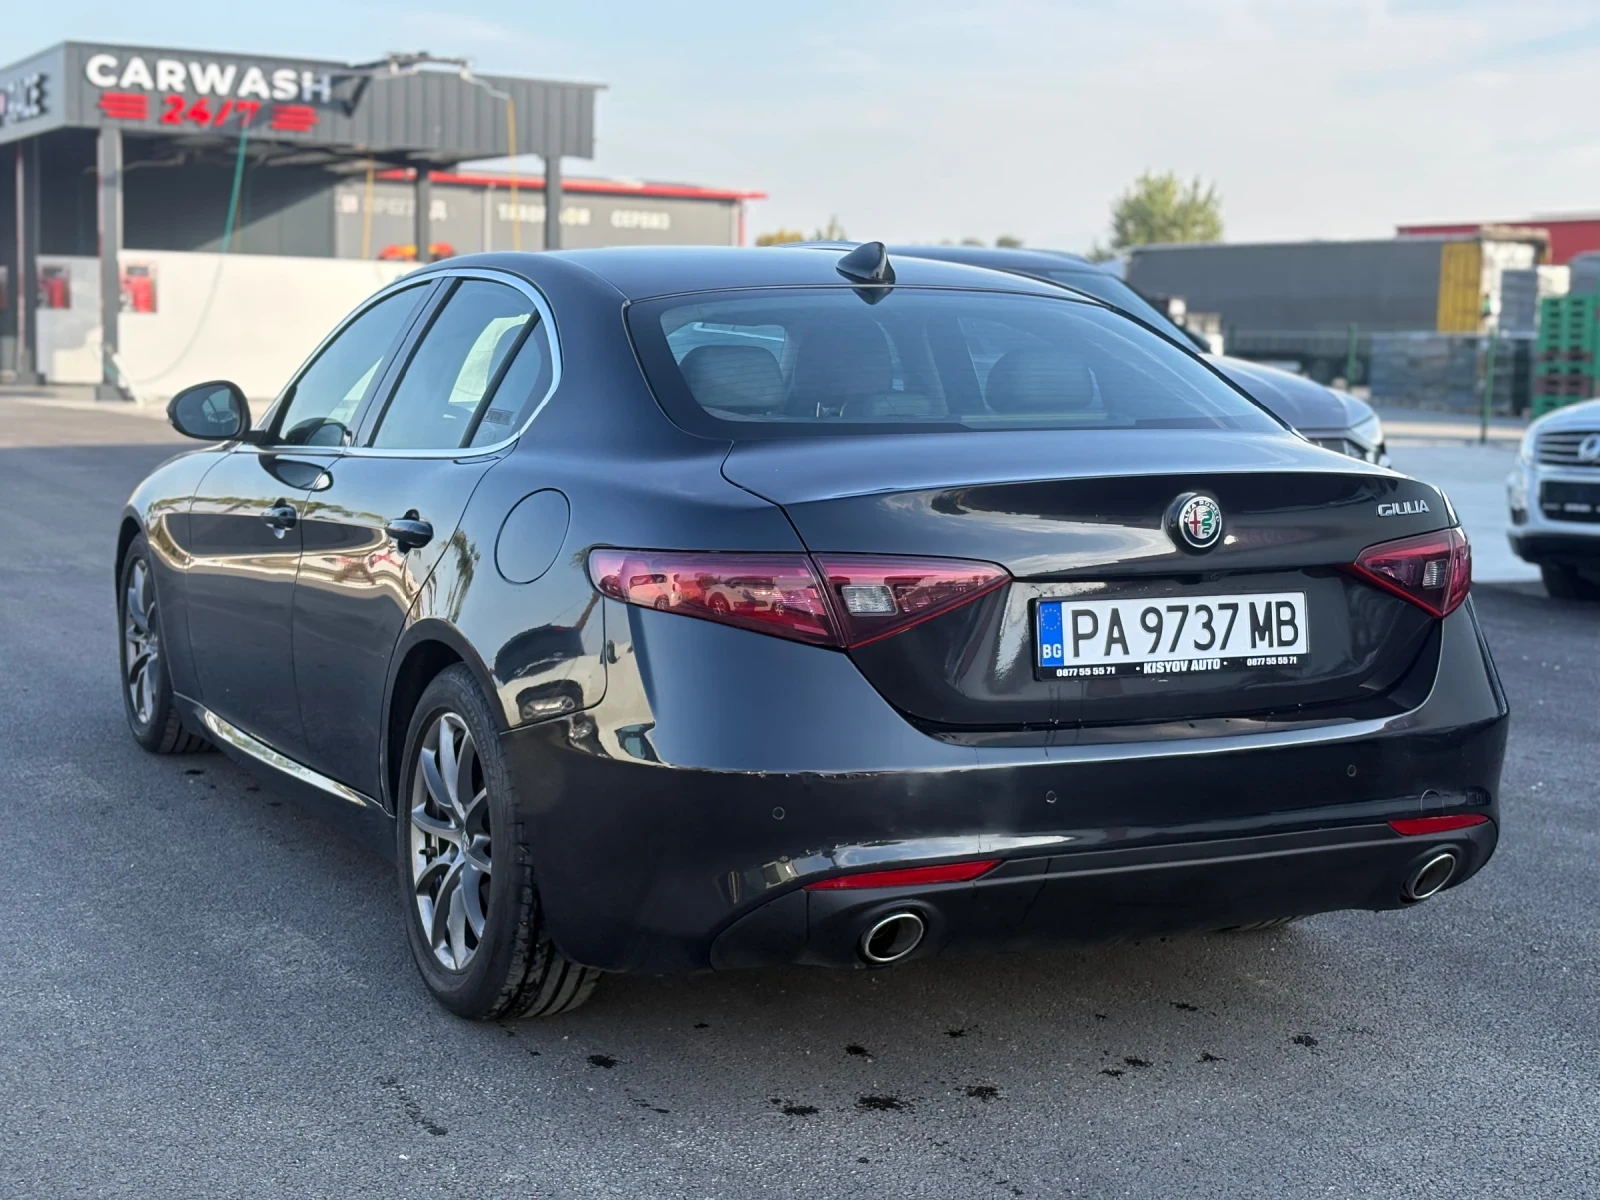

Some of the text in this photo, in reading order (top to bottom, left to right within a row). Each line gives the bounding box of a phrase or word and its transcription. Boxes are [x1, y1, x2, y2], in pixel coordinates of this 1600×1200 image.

[86, 54, 331, 103] CARWASH
[161, 94, 260, 128] 24/7
[1377, 500, 1430, 517] GIULIA
[1071, 600, 1299, 658] PA 9737 MB
[1042, 643, 1062, 659] BG
[1143, 658, 1220, 674] KISYOV AUTO
[1246, 656, 1297, 666] 0877 55 55 71
[1056, 666, 1116, 677] 0877 55 55 71
